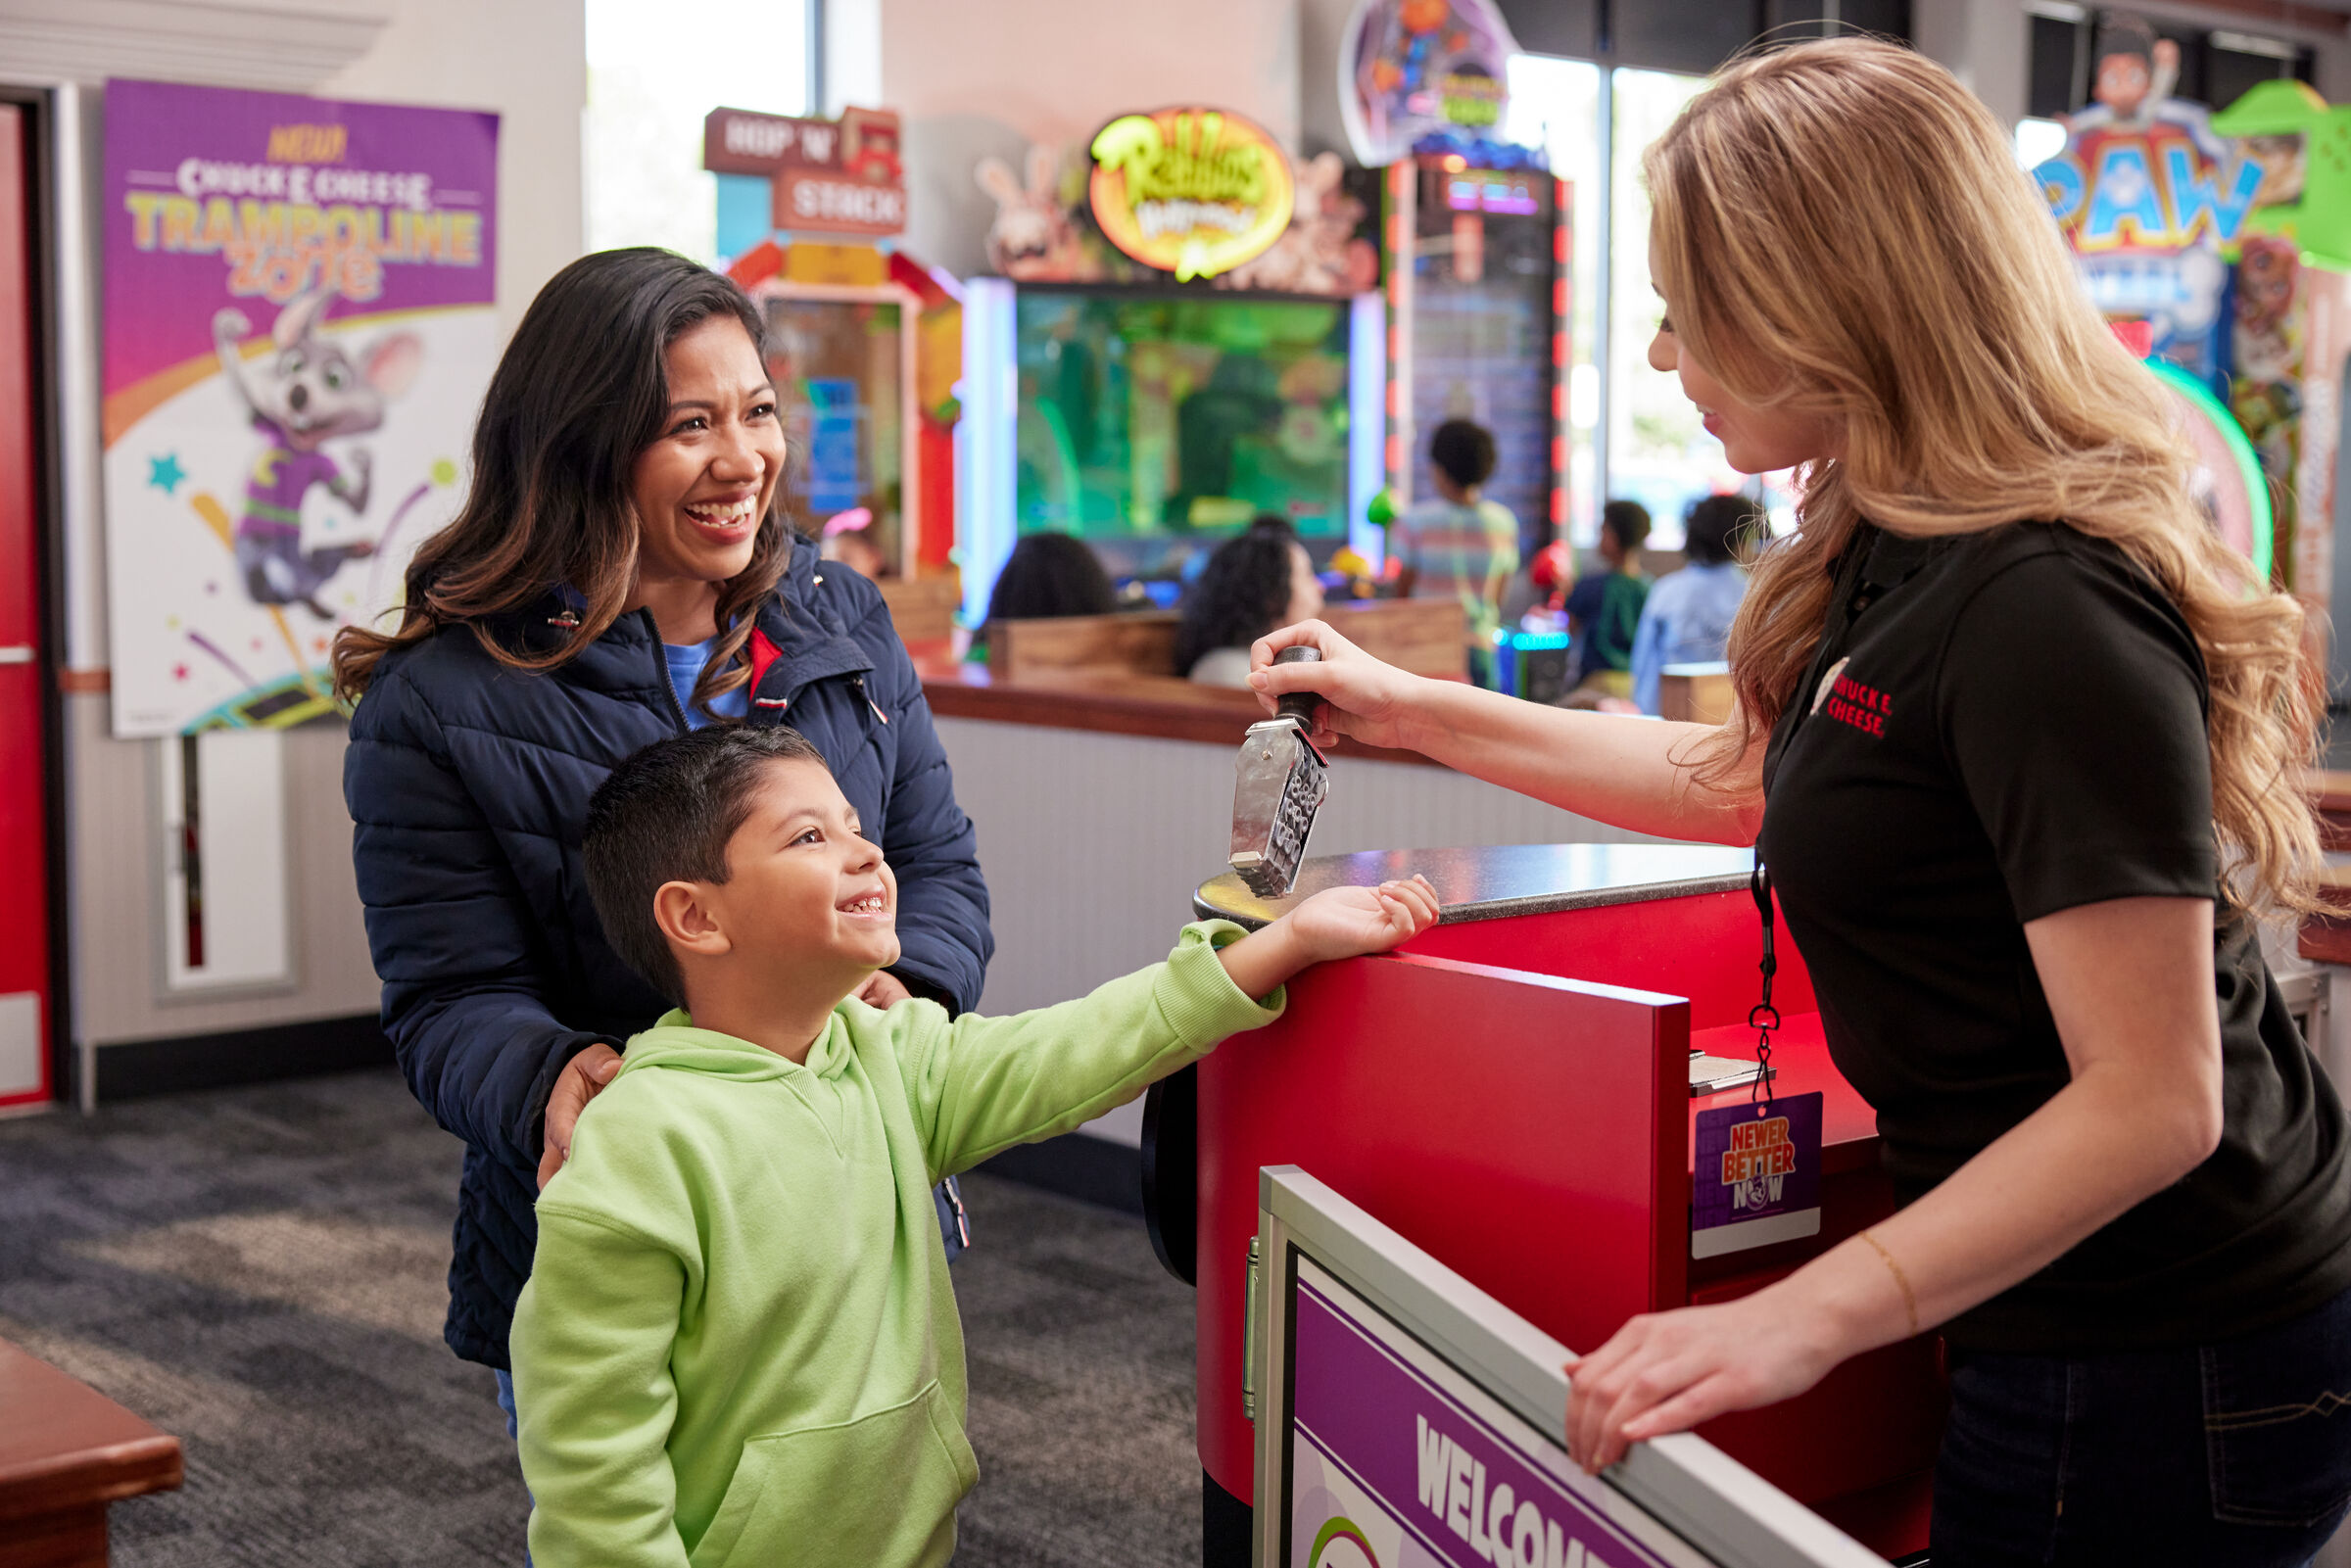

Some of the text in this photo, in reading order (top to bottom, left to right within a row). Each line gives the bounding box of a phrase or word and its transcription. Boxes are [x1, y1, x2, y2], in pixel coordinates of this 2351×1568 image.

[125, 192, 482, 267] TRAMPOLINE
[1731, 1117, 1789, 1152] NEWER
[1723, 1142, 1796, 1184] BETTER
